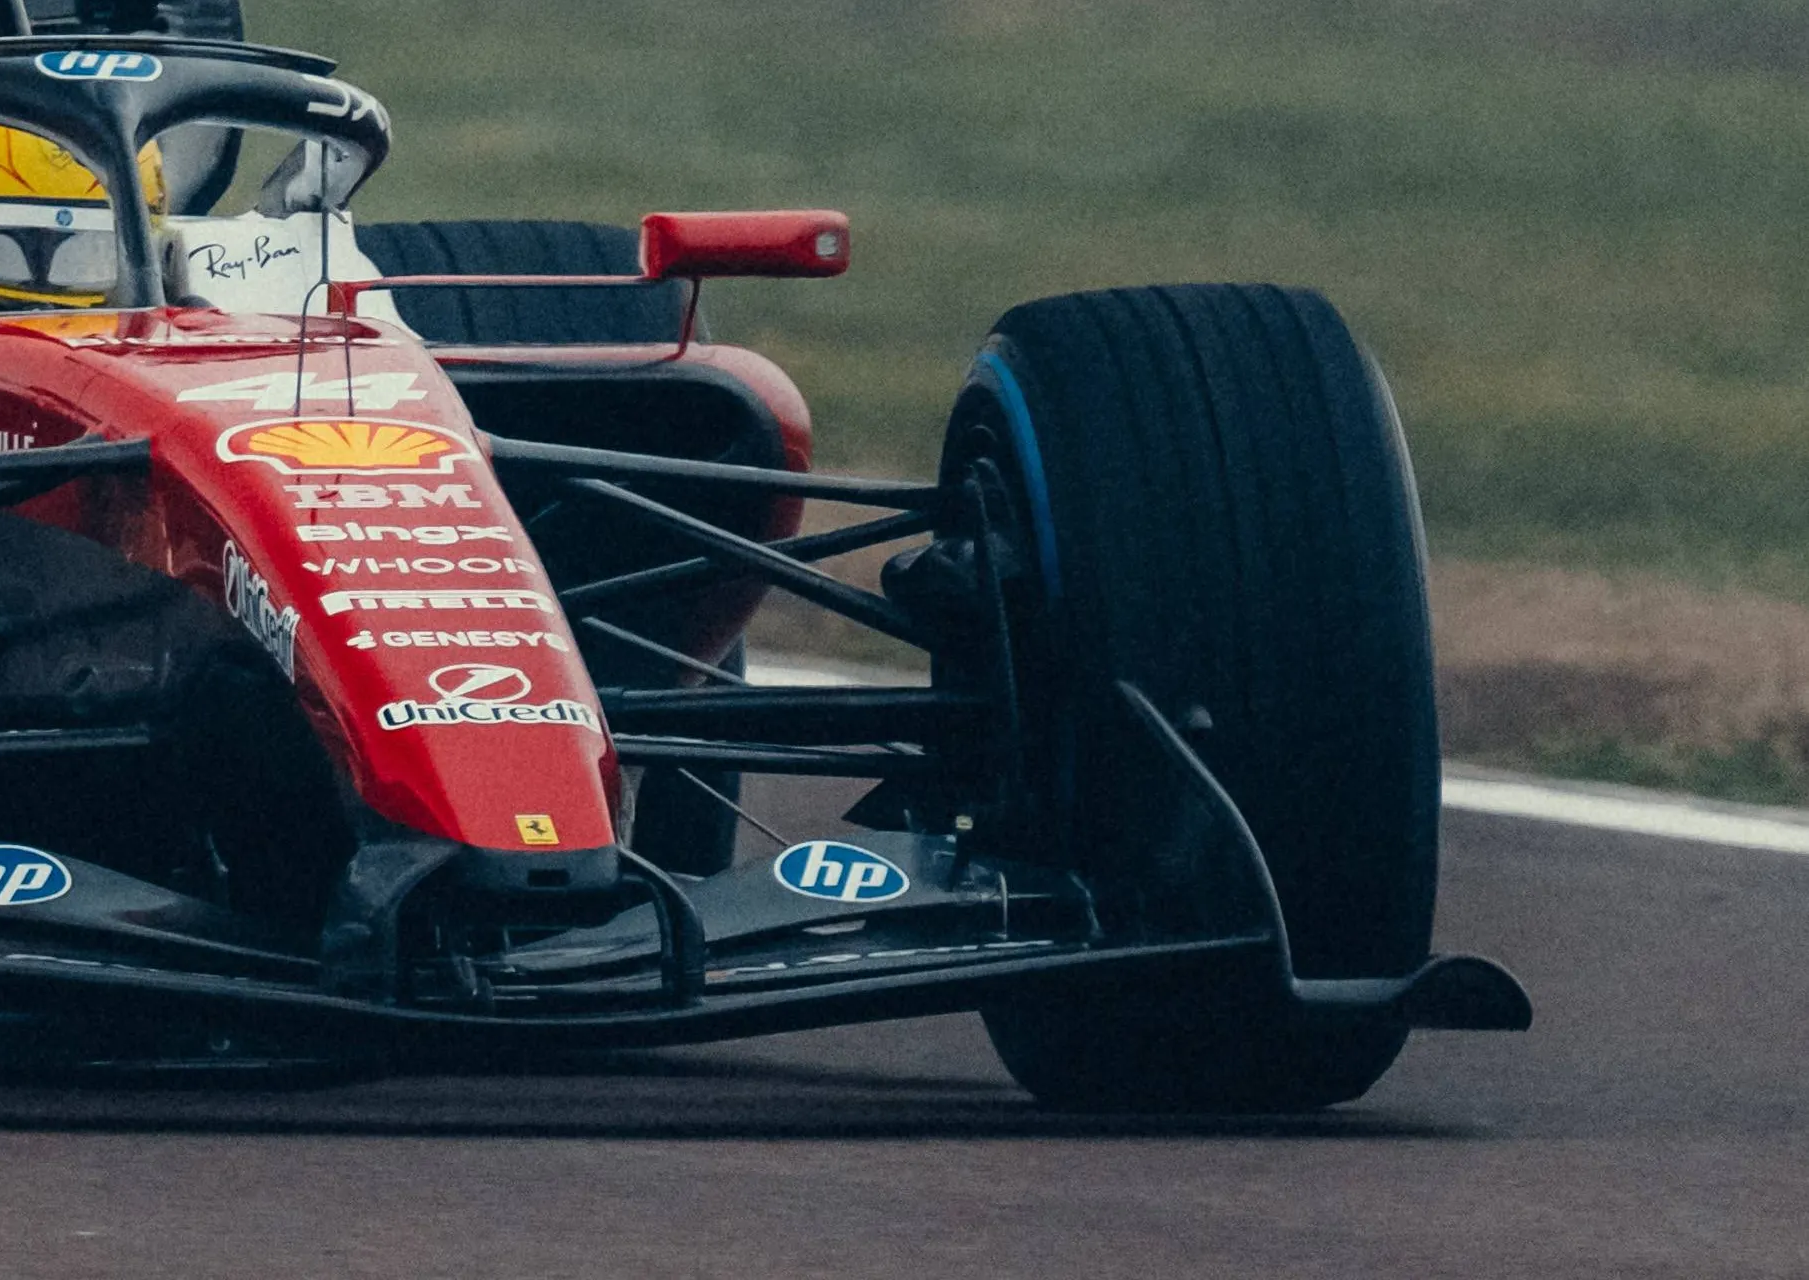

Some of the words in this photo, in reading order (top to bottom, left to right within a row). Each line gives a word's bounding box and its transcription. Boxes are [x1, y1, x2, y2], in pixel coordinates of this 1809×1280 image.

[55, 50, 147, 80] hp
[187, 234, 302, 280] Ray-Ban
[175, 372, 429, 411] 44
[283, 483, 482, 509] IBM
[379, 700, 598, 729] UniCredit
[796, 842, 891, 902] hp
